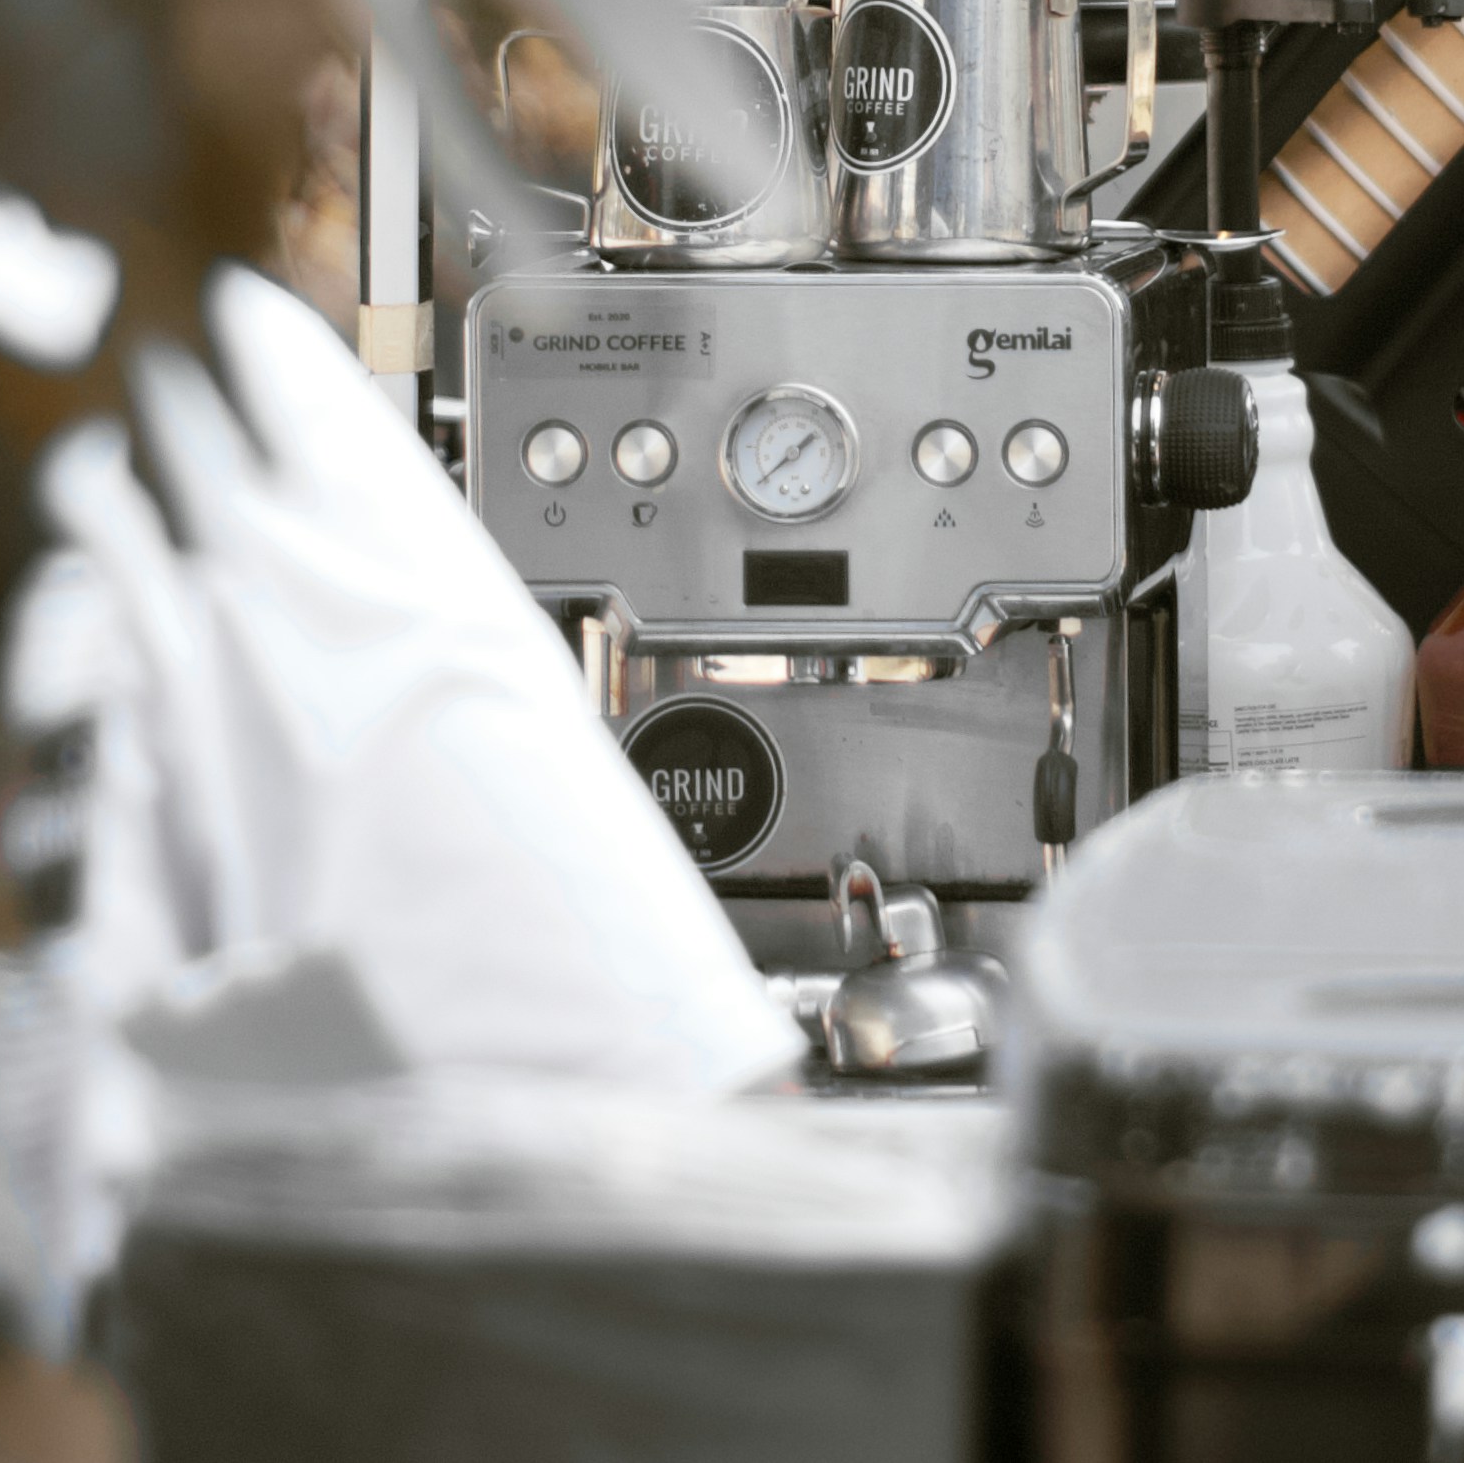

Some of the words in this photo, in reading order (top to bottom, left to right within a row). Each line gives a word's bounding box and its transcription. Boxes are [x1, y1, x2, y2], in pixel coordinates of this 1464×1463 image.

[844, 66, 914, 101] GRIND
[846, 101, 905, 116] COFFEE
[646, 145, 735, 165] COFFE
[533, 334, 601, 352] GRIND
[606, 334, 686, 352] COFFEE
[965, 326, 1072, 380] gemilai
[579, 362, 618, 372] MOBILE
[620, 362, 640, 372] BAR
[651, 767, 745, 802] GRIND
